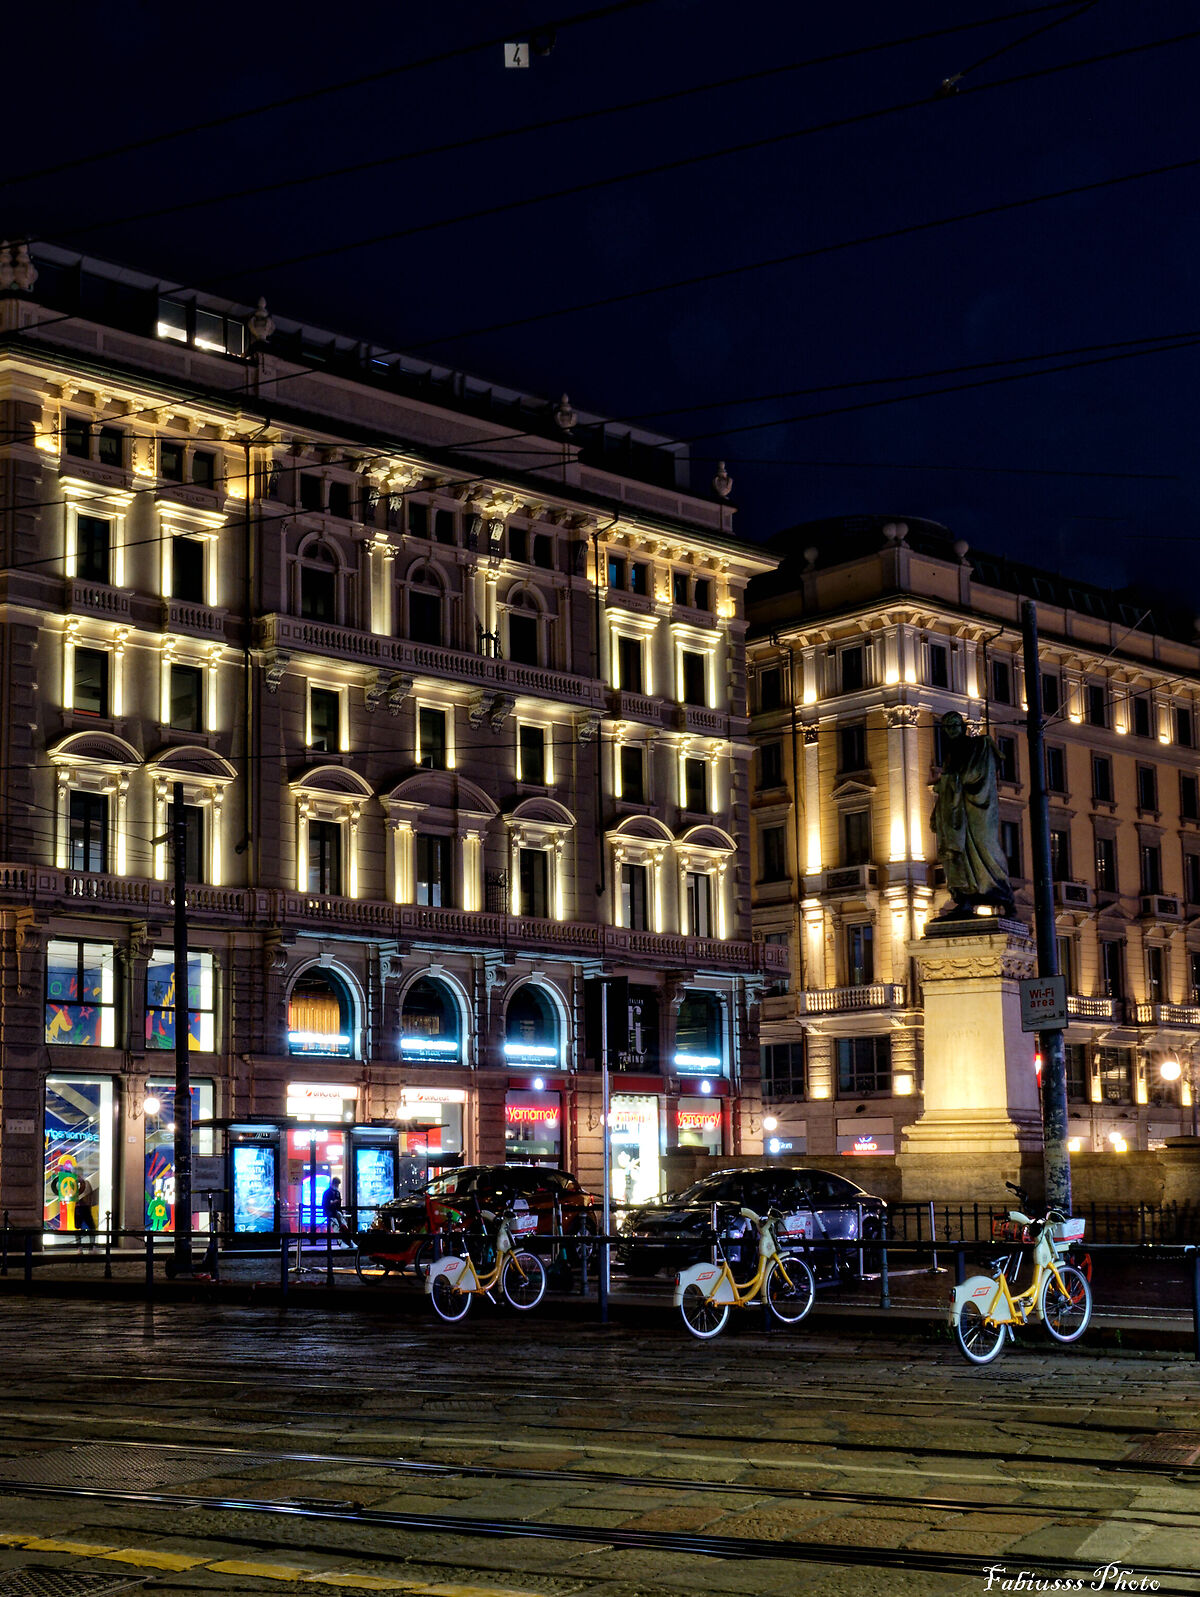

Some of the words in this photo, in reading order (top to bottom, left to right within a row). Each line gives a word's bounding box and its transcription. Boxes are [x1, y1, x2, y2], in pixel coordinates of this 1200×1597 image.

[512, 47, 522, 66] 4
[1029, 987, 1055, 999] Wi-Fi
[1030, 999, 1055, 1008] area
[854, 1143, 877, 1151] WIND
